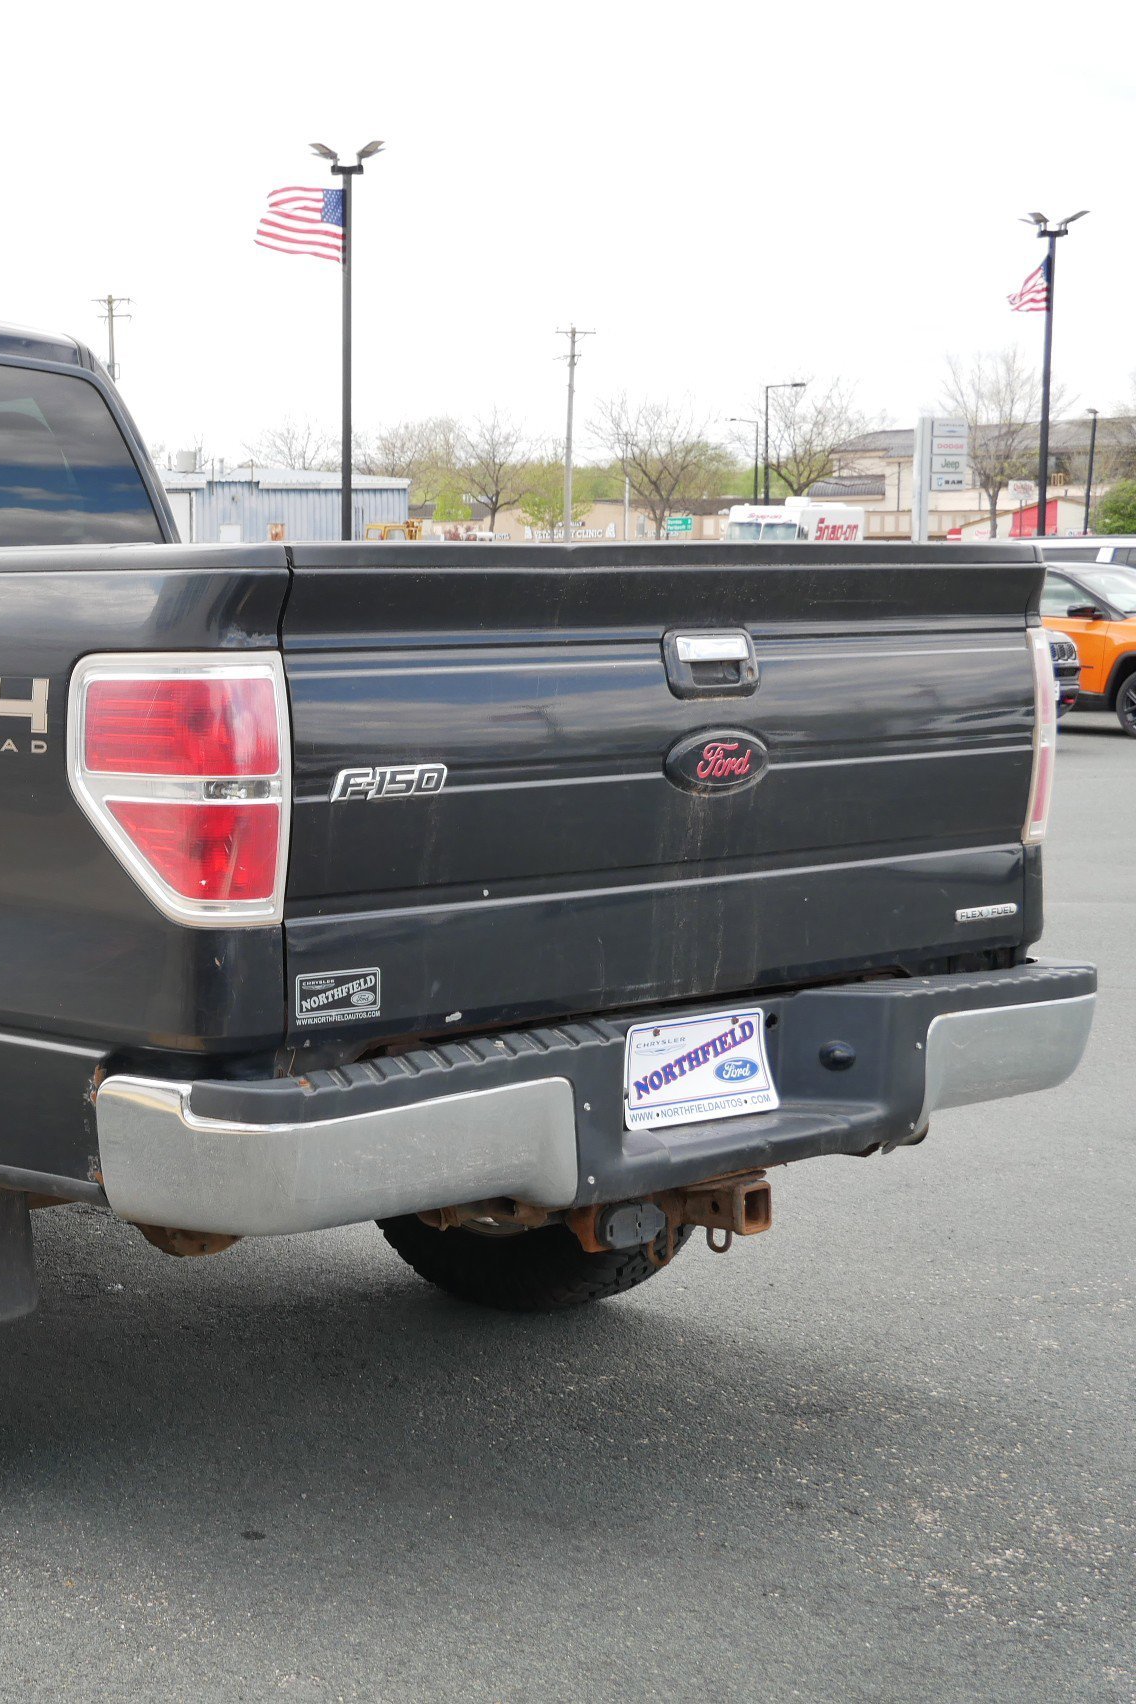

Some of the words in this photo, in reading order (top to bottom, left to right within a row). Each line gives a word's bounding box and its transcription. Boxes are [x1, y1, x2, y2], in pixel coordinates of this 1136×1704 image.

[941, 458, 960, 471] Jeep
[815, 517, 859, 541] Snap-on
[696, 742, 752, 779] Ford
[960, 910, 984, 920] FLEX
[990, 906, 1015, 916] FUEL
[300, 974, 376, 1012] NORTHFIELD
[635, 1036, 686, 1049] CHRYSLER
[632, 1019, 756, 1101] NORTHFIELD
[722, 1060, 752, 1080] Ford
